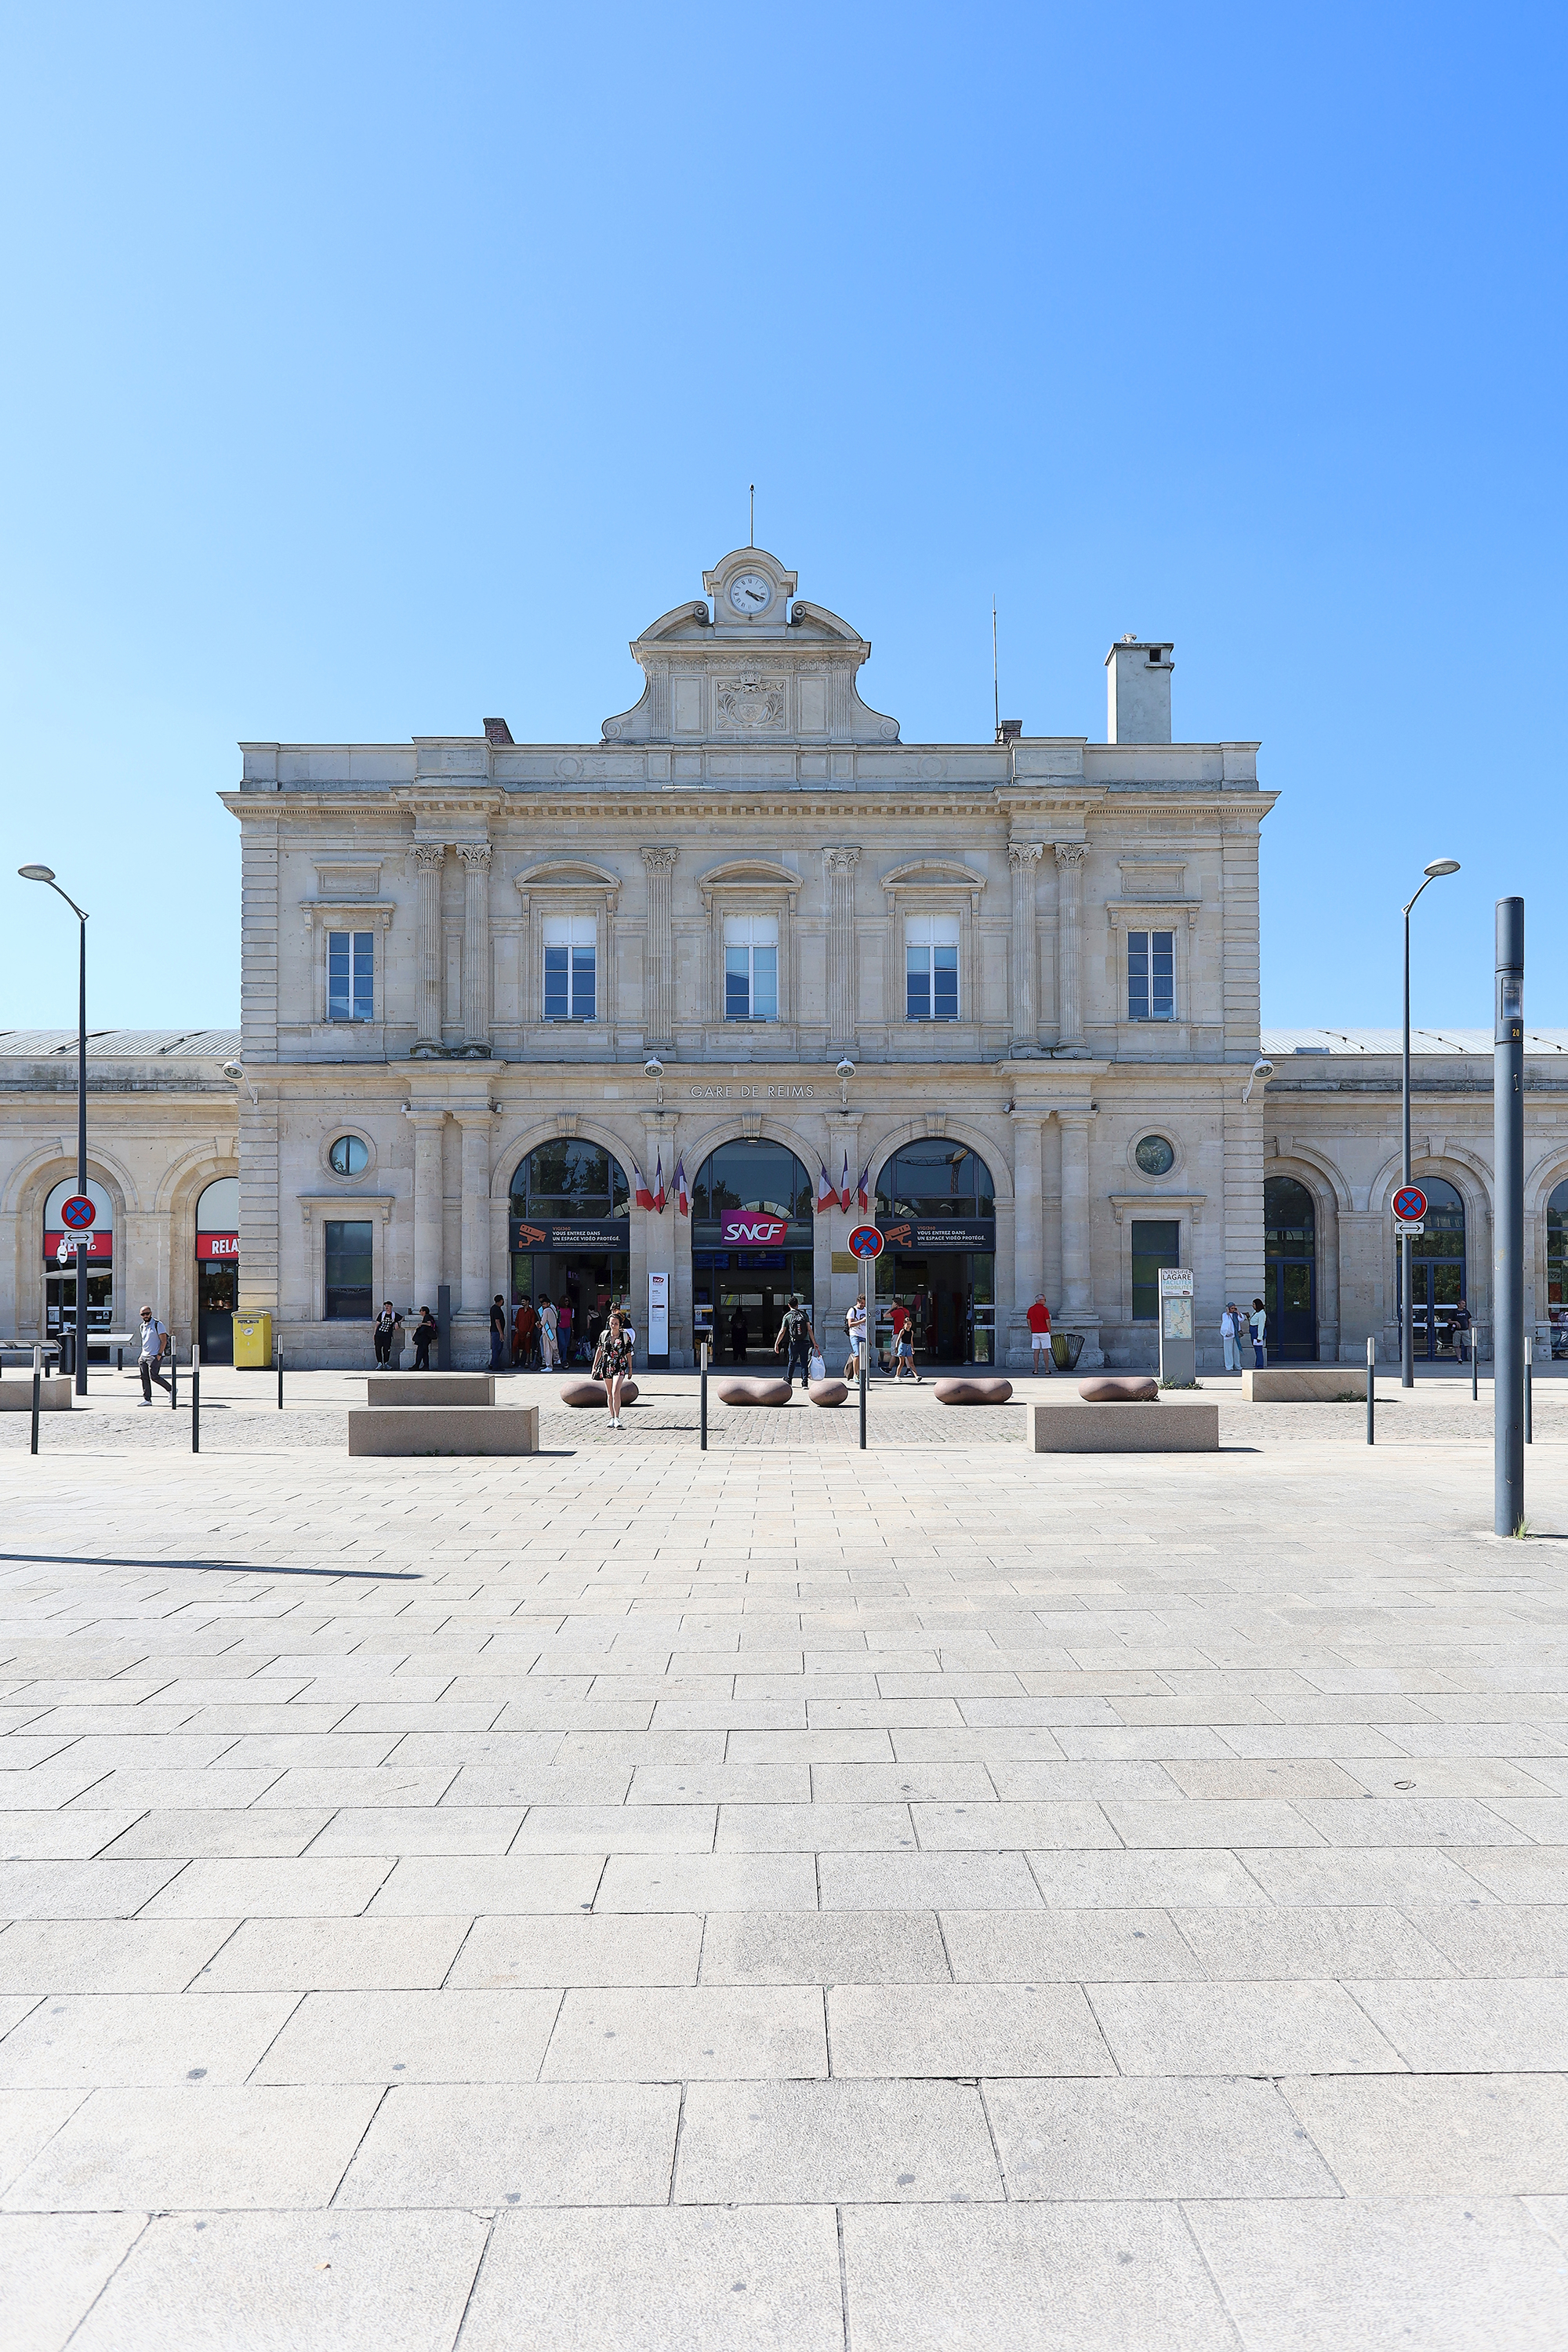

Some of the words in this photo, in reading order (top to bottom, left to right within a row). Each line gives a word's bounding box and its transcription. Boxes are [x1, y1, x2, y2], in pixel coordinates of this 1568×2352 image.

[1512, 1028, 1520, 1037] 20
[690, 1085, 732, 1098] GARE
[741, 1085, 759, 1098] DE
[768, 1085, 814, 1098] REIMS
[723, 1223, 783, 1241] SNCF
[212, 1239, 238, 1254] RELA
